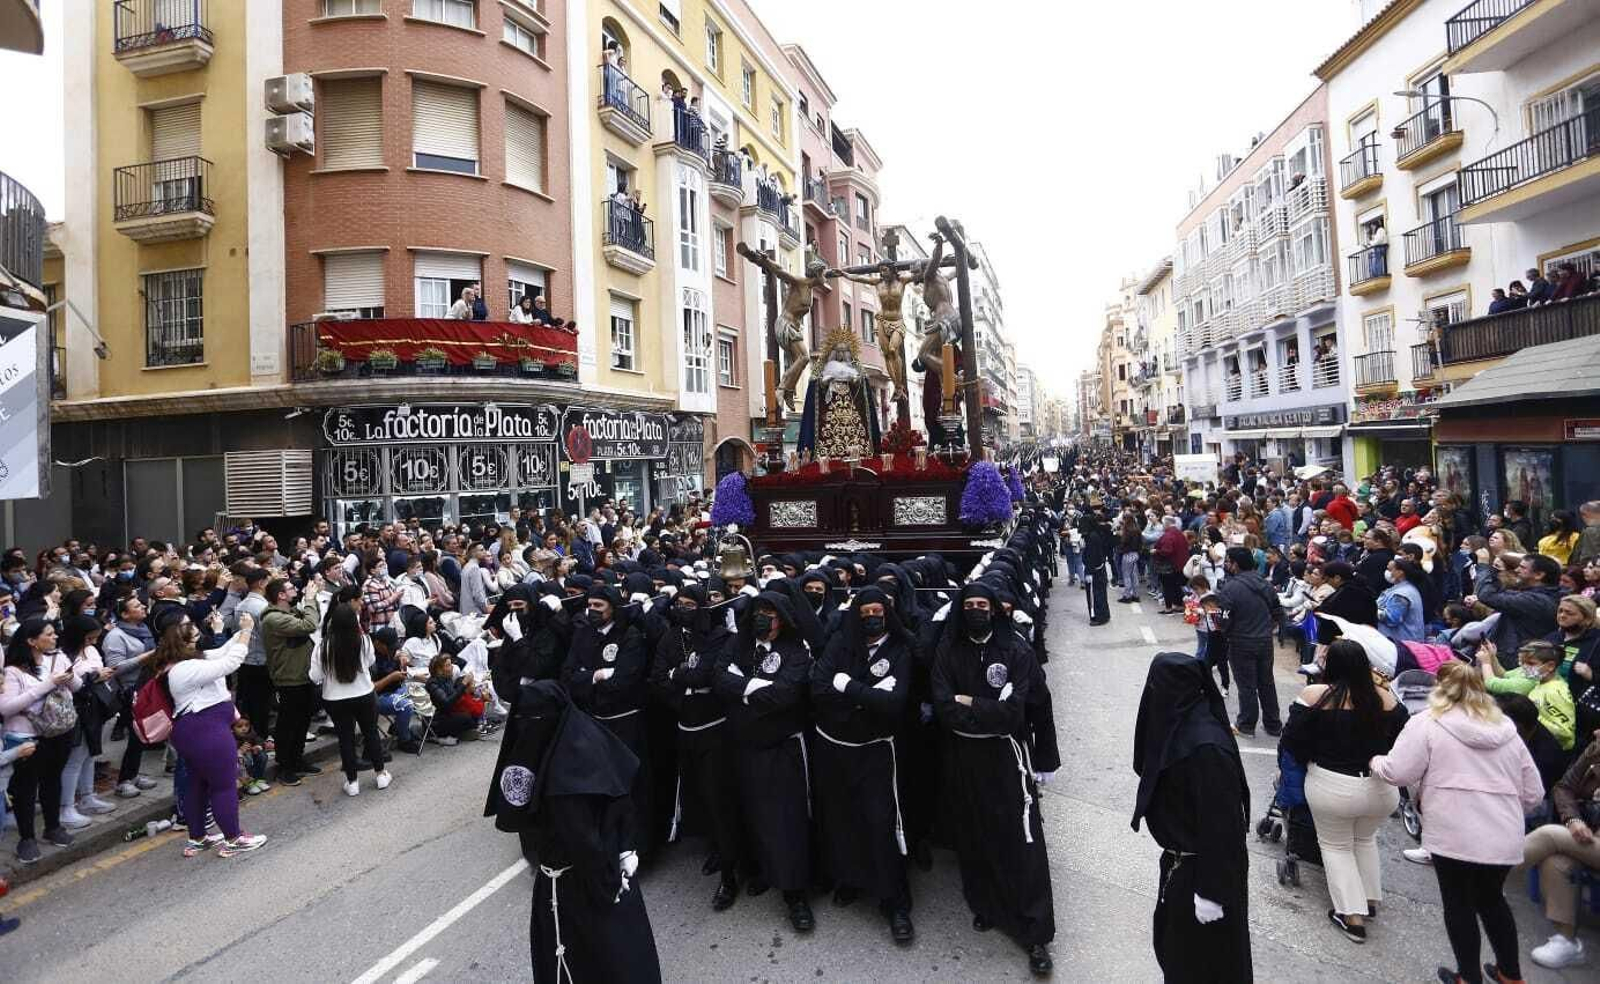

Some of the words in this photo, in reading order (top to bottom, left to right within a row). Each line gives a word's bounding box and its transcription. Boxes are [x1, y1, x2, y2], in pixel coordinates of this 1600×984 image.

[365, 423, 384, 439] La
[383, 407, 473, 438] factoría
[484, 407, 533, 437] Plata
[635, 415, 663, 440] Plata
[344, 460, 370, 481] 5€
[472, 456, 496, 476] 5€
[522, 455, 546, 474] 10€
